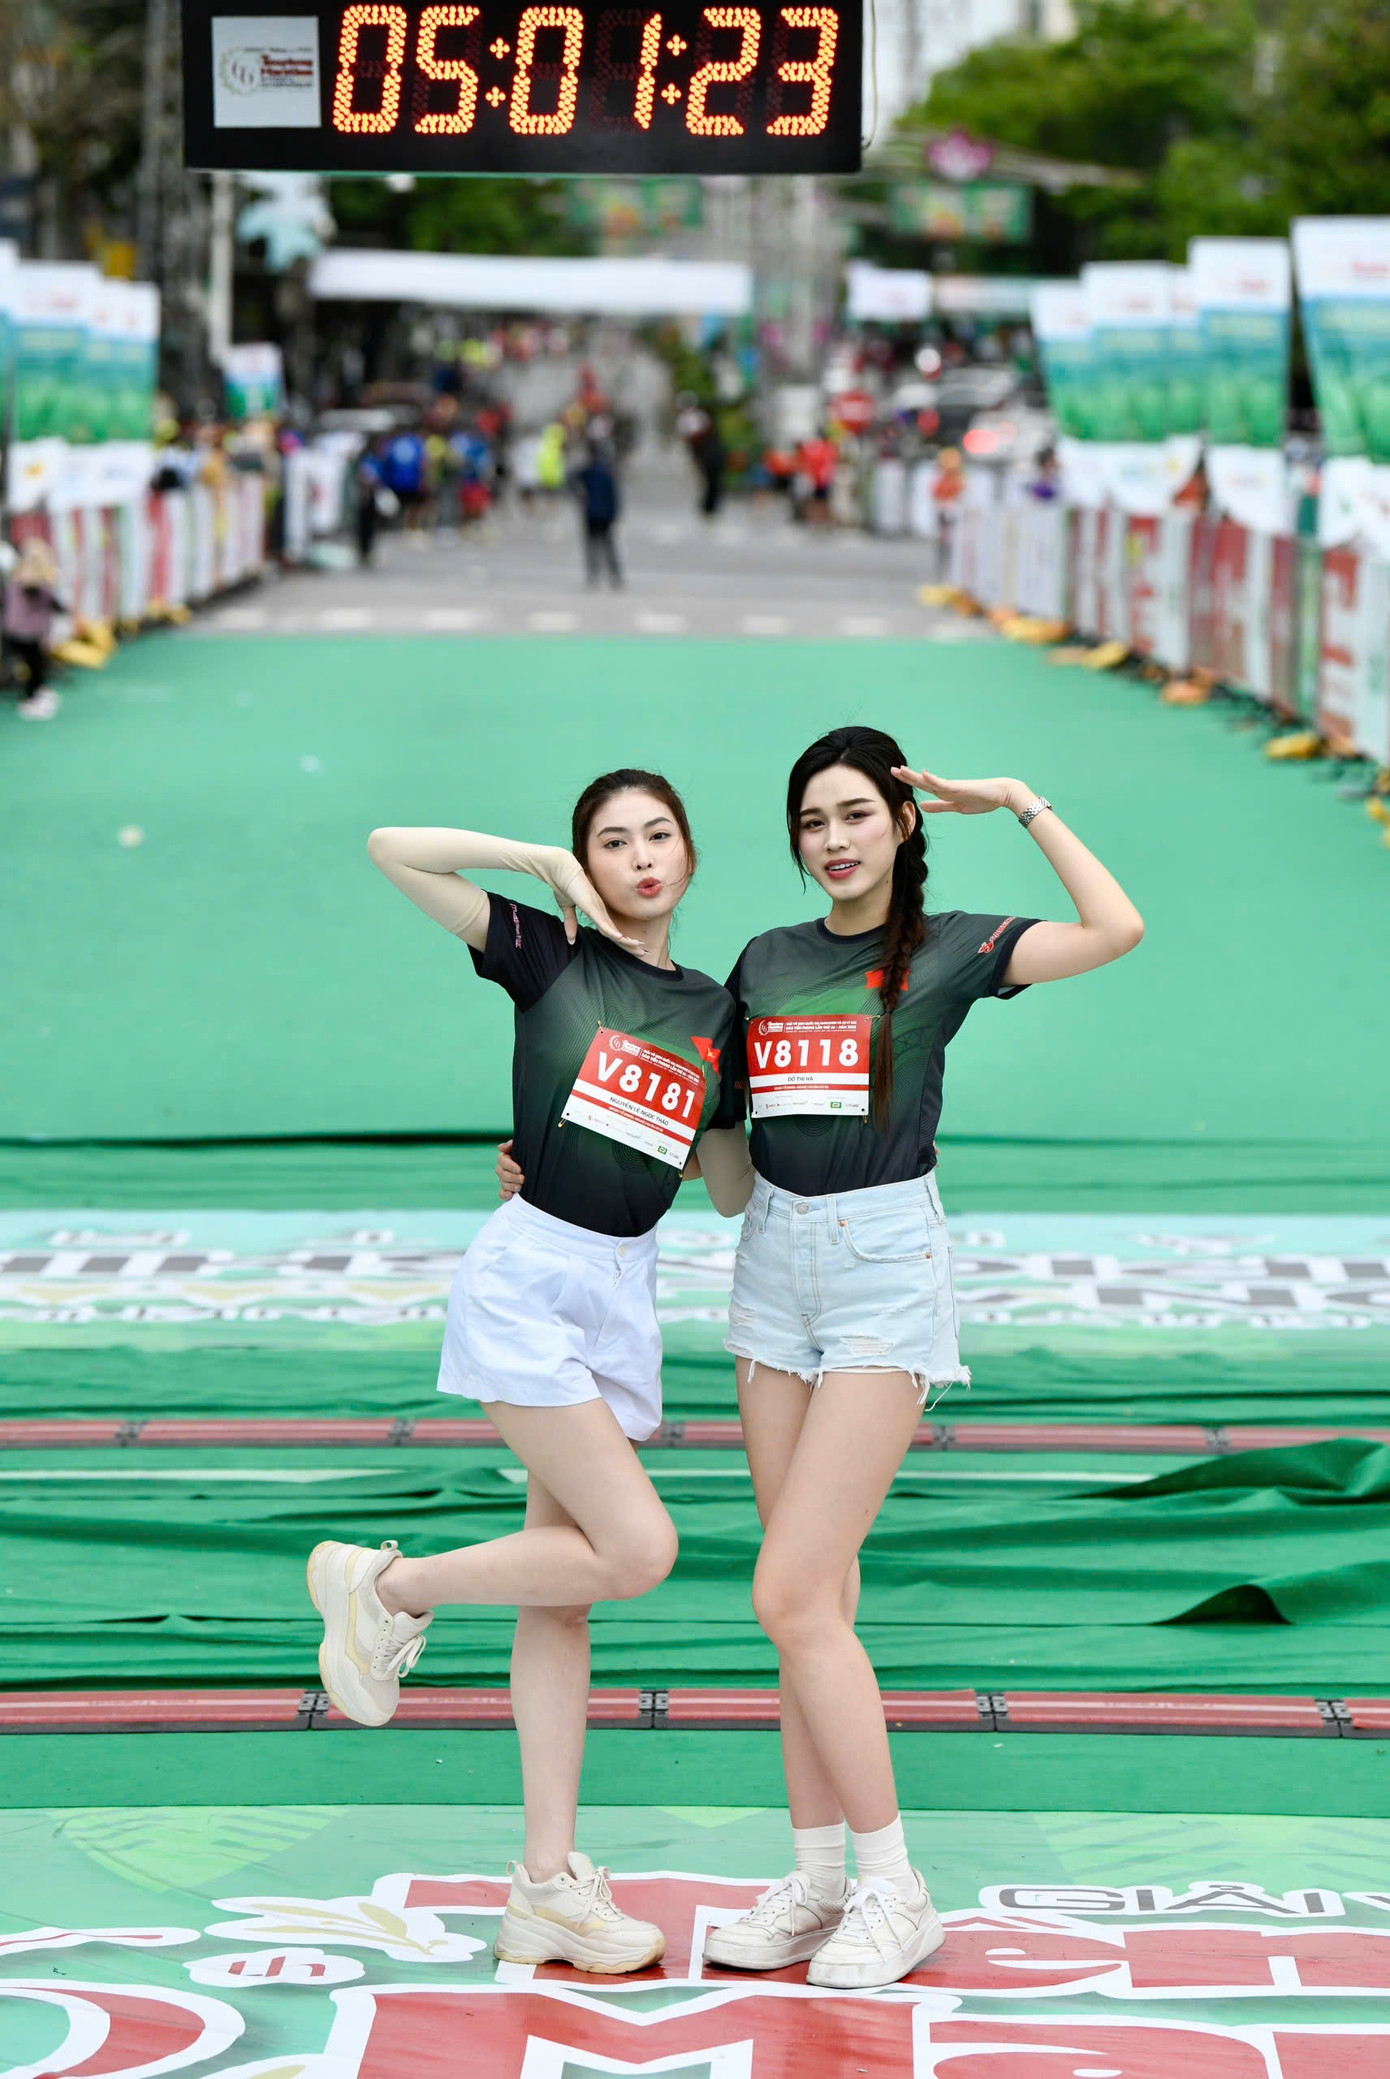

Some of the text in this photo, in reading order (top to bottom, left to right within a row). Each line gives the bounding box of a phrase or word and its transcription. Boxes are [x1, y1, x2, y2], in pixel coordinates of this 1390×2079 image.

[332, 4, 839, 135] 05:01:23
[754, 1038, 859, 1069] V8118
[598, 1051, 695, 1119] V8181
[999, 1884, 1326, 1914] GIẢI
